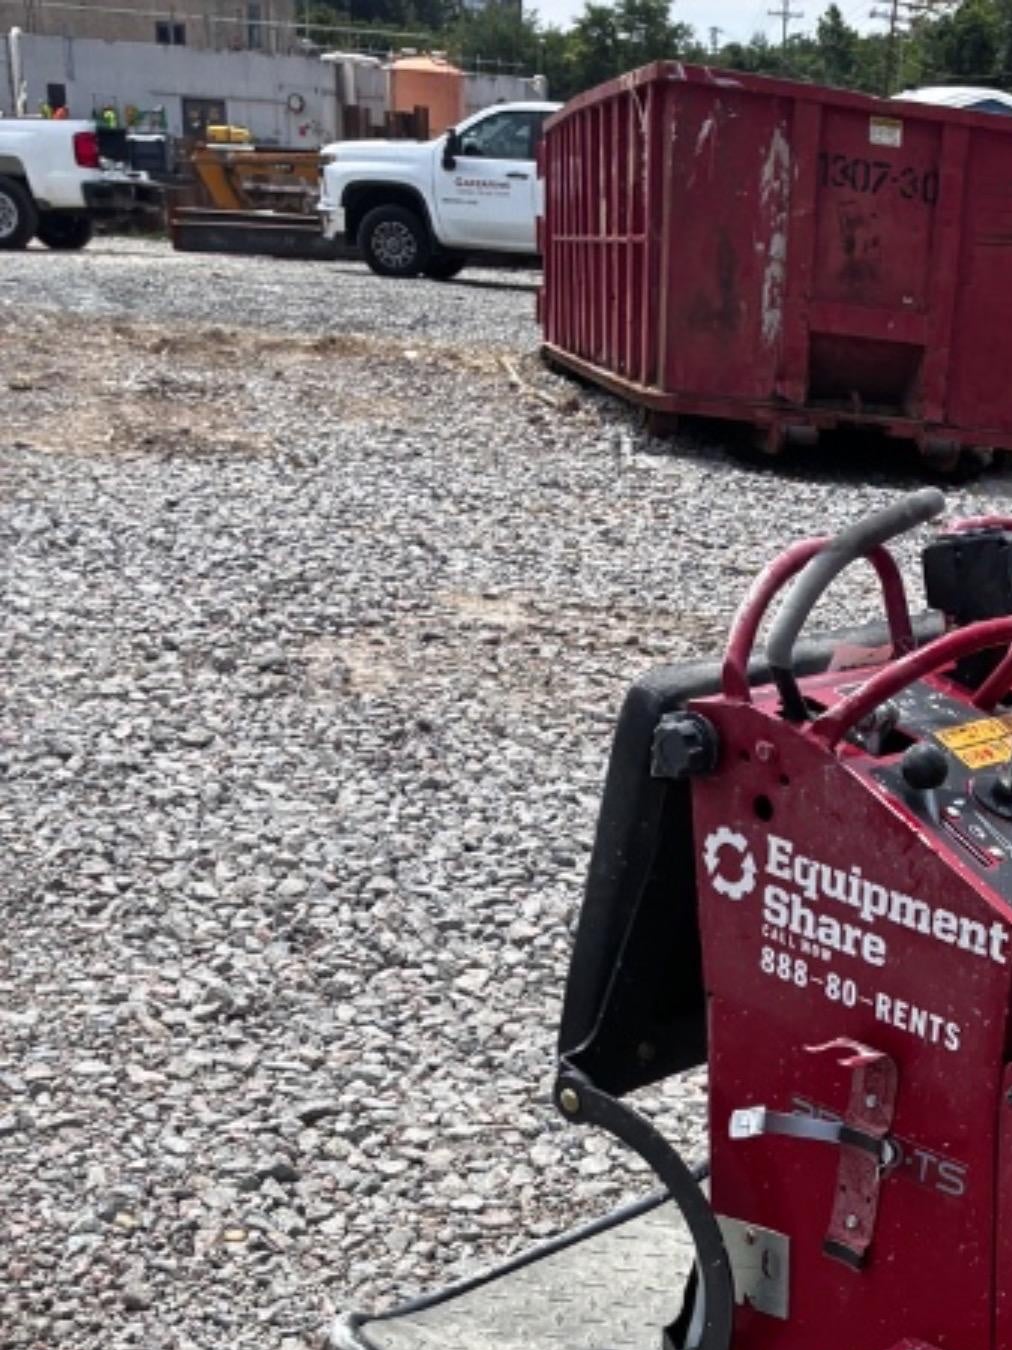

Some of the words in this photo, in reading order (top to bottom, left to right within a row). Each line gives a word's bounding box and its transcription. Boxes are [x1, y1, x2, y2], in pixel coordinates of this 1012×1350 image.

[818, 151, 941, 207] 1307-30
[763, 884, 887, 967] Share
[765, 833, 1009, 965] Equipment
[761, 923, 796, 949] CALL
[800, 940, 833, 962] NOW
[760, 946, 962, 1051] 888-80-RENTS
